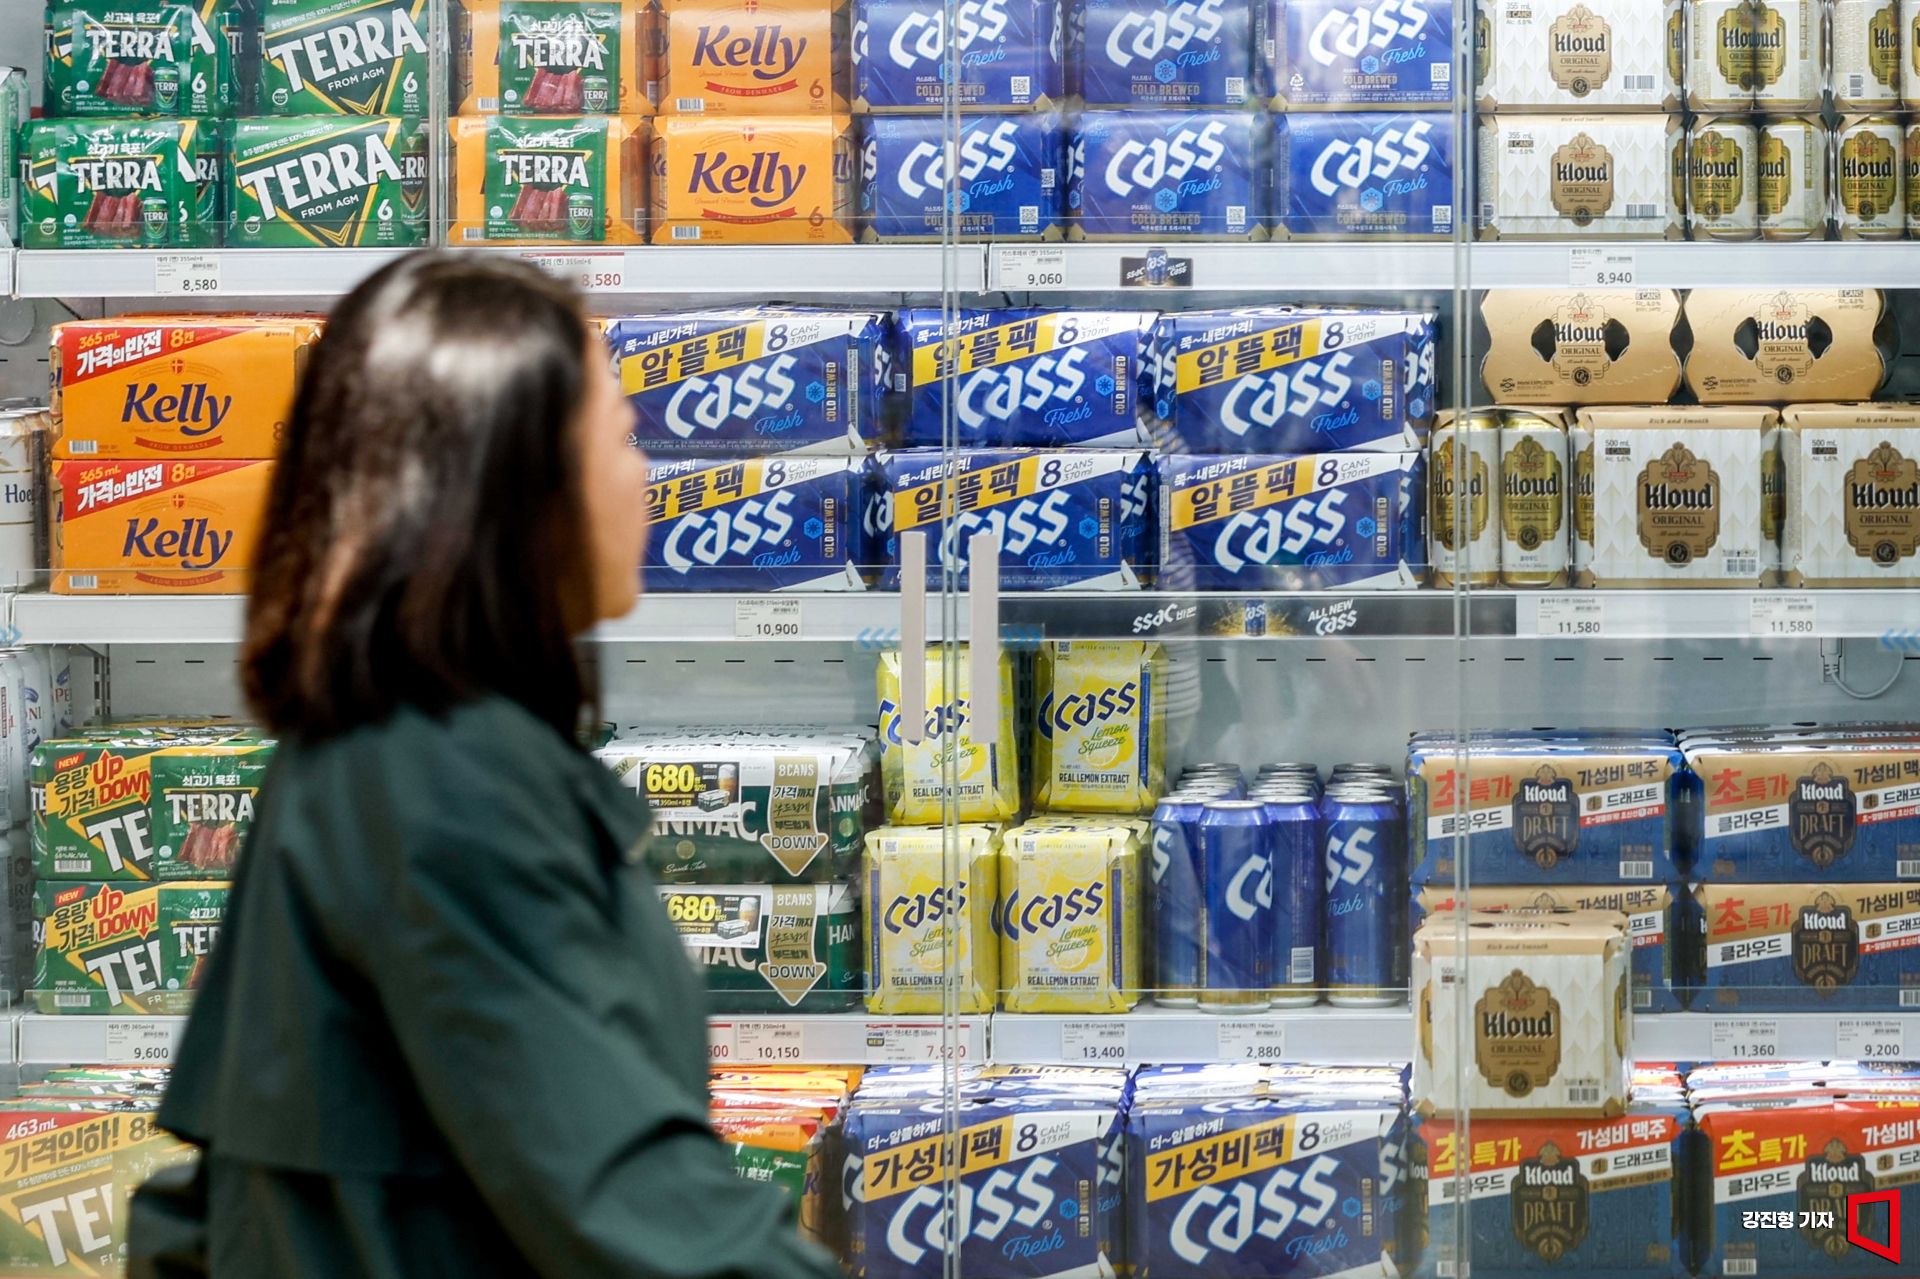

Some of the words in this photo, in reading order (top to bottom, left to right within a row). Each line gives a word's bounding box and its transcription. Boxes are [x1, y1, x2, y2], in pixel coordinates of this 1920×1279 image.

[86, 27, 174, 62] TERRA
[269, 7, 428, 93] TERRA
[513, 38, 604, 70] TERRA
[692, 24, 806, 80] Kelly
[1381, 43, 1425, 66] Fresh
[1555, 32, 1606, 55] Kloud
[961, 49, 1006, 75] Fresh
[1177, 49, 1221, 71] Fresh
[1560, 57, 1599, 65] ORIGINAL
[328, 77, 359, 91] FROM
[361, 67, 385, 84] AGM
[402, 71, 418, 92] 6
[809, 78, 824, 99] 6
[1131, 84, 1157, 96] COLD
[1159, 84, 1200, 96] BREWED
[499, 151, 589, 187] TERRA
[1105, 121, 1227, 199] Cass
[1310, 120, 1432, 197] Cass
[71, 162, 162, 192] TERRA
[240, 134, 401, 221] TERRA
[688, 151, 806, 208] Kelly
[1556, 161, 1608, 184] Kloud
[970, 178, 1014, 200] Fresh
[1177, 178, 1222, 200] Fresh
[1383, 177, 1428, 198] Fresh
[1562, 186, 1600, 194] ORIGINAL
[301, 203, 333, 219] FROM
[334, 195, 359, 208] AGM
[377, 199, 393, 220] 6
[809, 207, 825, 227] 6
[1131, 213, 1157, 226] COLD
[1159, 213, 1200, 226] BREWED
[183, 279, 217, 292] 8,580
[582, 274, 621, 288] 8,580
[1028, 272, 1062, 287] 9,060
[1598, 272, 1632, 285] 8,940
[767, 324, 788, 351] 8
[791, 323, 820, 337] CANS
[1058, 318, 1078, 345] 8
[1323, 322, 1344, 349] 8
[1346, 320, 1376, 335] CANS
[1561, 345, 1601, 355] ORIGINAL
[1764, 344, 1804, 353] ORIGINAL
[826, 362, 837, 398] BREWED
[958, 346, 1089, 429] Cass
[1383, 360, 1393, 396] BREWED
[665, 354, 798, 438] Cass
[1220, 351, 1355, 436] Cass
[121, 383, 232, 436] Kelly
[826, 400, 837, 422] COLD
[1383, 398, 1393, 419] COLD
[1605, 439, 1619, 448] 500
[1621, 439, 1631, 448] mL
[1811, 439, 1826, 447] 500
[1827, 439, 1837, 447] mL
[765, 461, 786, 487] 8
[789, 458, 818, 472] CANS
[1041, 459, 1062, 487] 8
[1064, 458, 1094, 472] CANS
[1317, 459, 1338, 487] 8
[1341, 457, 1370, 472] CANS
[1645, 480, 1714, 510] Kloud
[1851, 480, 1920, 510] Kloud
[1214, 487, 1349, 574] Cass
[1652, 514, 1704, 526] ORIGINAL
[1859, 514, 1912, 525] ORIGINAL
[663, 489, 796, 574] Cass
[122, 518, 233, 570] Kelly
[1307, 609, 1327, 622] ALL
[1328, 599, 1354, 616] NEW
[756, 624, 798, 635] 10,900
[1559, 621, 1600, 634] 11,580
[1770, 620, 1813, 633] 11,580
[1054, 682, 1136, 732] Cass
[1091, 723, 1130, 742] Lemon
[1078, 736, 1126, 755] Squeeze
[58, 754, 81, 770] NEW
[1577, 765, 1624, 787] 가성비
[1627, 760, 1659, 778] 맥주
[1854, 762, 1901, 784] 가성비
[53, 767, 89, 794] 용량
[93, 757, 124, 785] UP
[182, 775, 213, 786] 쇠고기
[215, 775, 240, 785] 육포!
[647, 764, 695, 792] 680
[1059, 773, 1075, 784] REAL
[1076, 773, 1099, 784] LEMON
[1100, 773, 1129, 784] EXTRACT
[1709, 767, 1790, 807] 초특가
[1432, 769, 1512, 808] 초특가
[1524, 785, 1567, 802] Kloud
[1607, 788, 1658, 806] 드래프트
[1801, 783, 1844, 800] Kloud
[165, 793, 255, 825] TERRA
[1718, 809, 1779, 832] 클라우드
[1523, 816, 1569, 841] DRAFT
[1800, 814, 1846, 840] DRAFT
[771, 837, 818, 849] DOWN
[58, 890, 80, 904] NEW
[667, 895, 715, 922] 680
[1021, 882, 1104, 934] Cass
[1627, 889, 1657, 908] 맥주
[1857, 892, 1903, 914] 가성비
[54, 902, 89, 928] 용량
[93, 892, 124, 920] UP
[1712, 897, 1791, 936] 초특가
[1804, 912, 1846, 930] Kloud
[59, 925, 97, 952] 가격
[100, 902, 156, 939] DOWN
[1059, 924, 1098, 942] Lemon
[1046, 936, 1095, 958] Squeeze
[1721, 938, 1782, 962] 클라우드
[1802, 943, 1848, 969] DRAFT
[769, 965, 816, 979] DOWN
[1028, 976, 1044, 986] REAL
[1046, 976, 1068, 986] LEMON
[1070, 976, 1100, 986] EXTRACT
[1482, 1011, 1553, 1038] Kloud
[134, 1048, 169, 1060] 9,600
[758, 1047, 800, 1059] 10,150
[1083, 1046, 1125, 1058] 13,400
[1246, 1046, 1281, 1058] 2,880
[1491, 1046, 1544, 1054] ORIGINAL
[1733, 1045, 1775, 1056] 11,360
[1864, 1045, 1900, 1056] 9,200
[1576, 1128, 1629, 1150] 가성비
[1631, 1119, 1667, 1140] 맥주
[1862, 1125, 1913, 1146] 가성비
[4, 1117, 120, 1177] 가격인하!
[1434, 1132, 1522, 1173] 초특가
[1719, 1129, 1807, 1170] 초특가
[1613, 1149, 1669, 1170] 드래프트
[1525, 1166, 1574, 1186] Kloud
[1728, 1171, 1791, 1196] 클라우드
[1170, 1155, 1343, 1265] Cass
[1523, 1200, 1577, 1232] DRAFT
[1003, 1228, 1064, 1262] Fresh
[1285, 1226, 1349, 1259] Fresh
